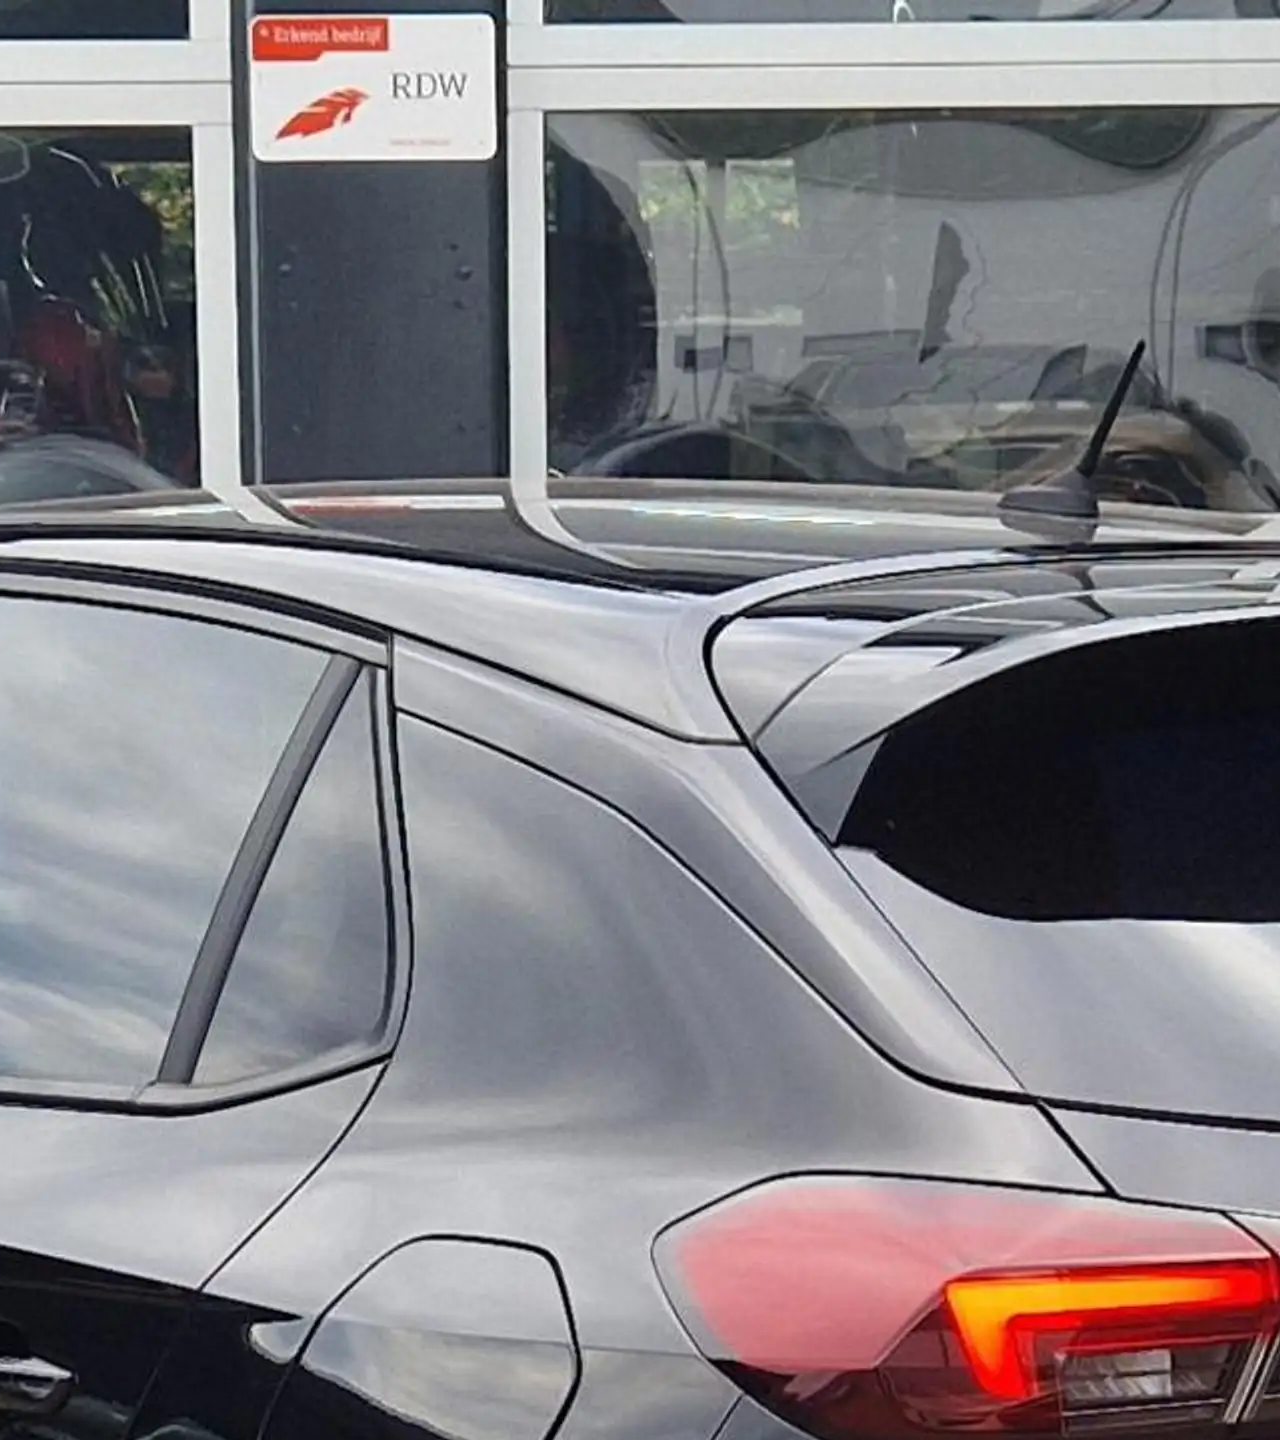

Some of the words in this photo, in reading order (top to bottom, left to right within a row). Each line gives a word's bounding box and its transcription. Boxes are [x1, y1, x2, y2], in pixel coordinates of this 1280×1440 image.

[273, 25, 328, 44] Erkend
[331, 25, 382, 48] bedrijf
[391, 72, 469, 99] RDW
